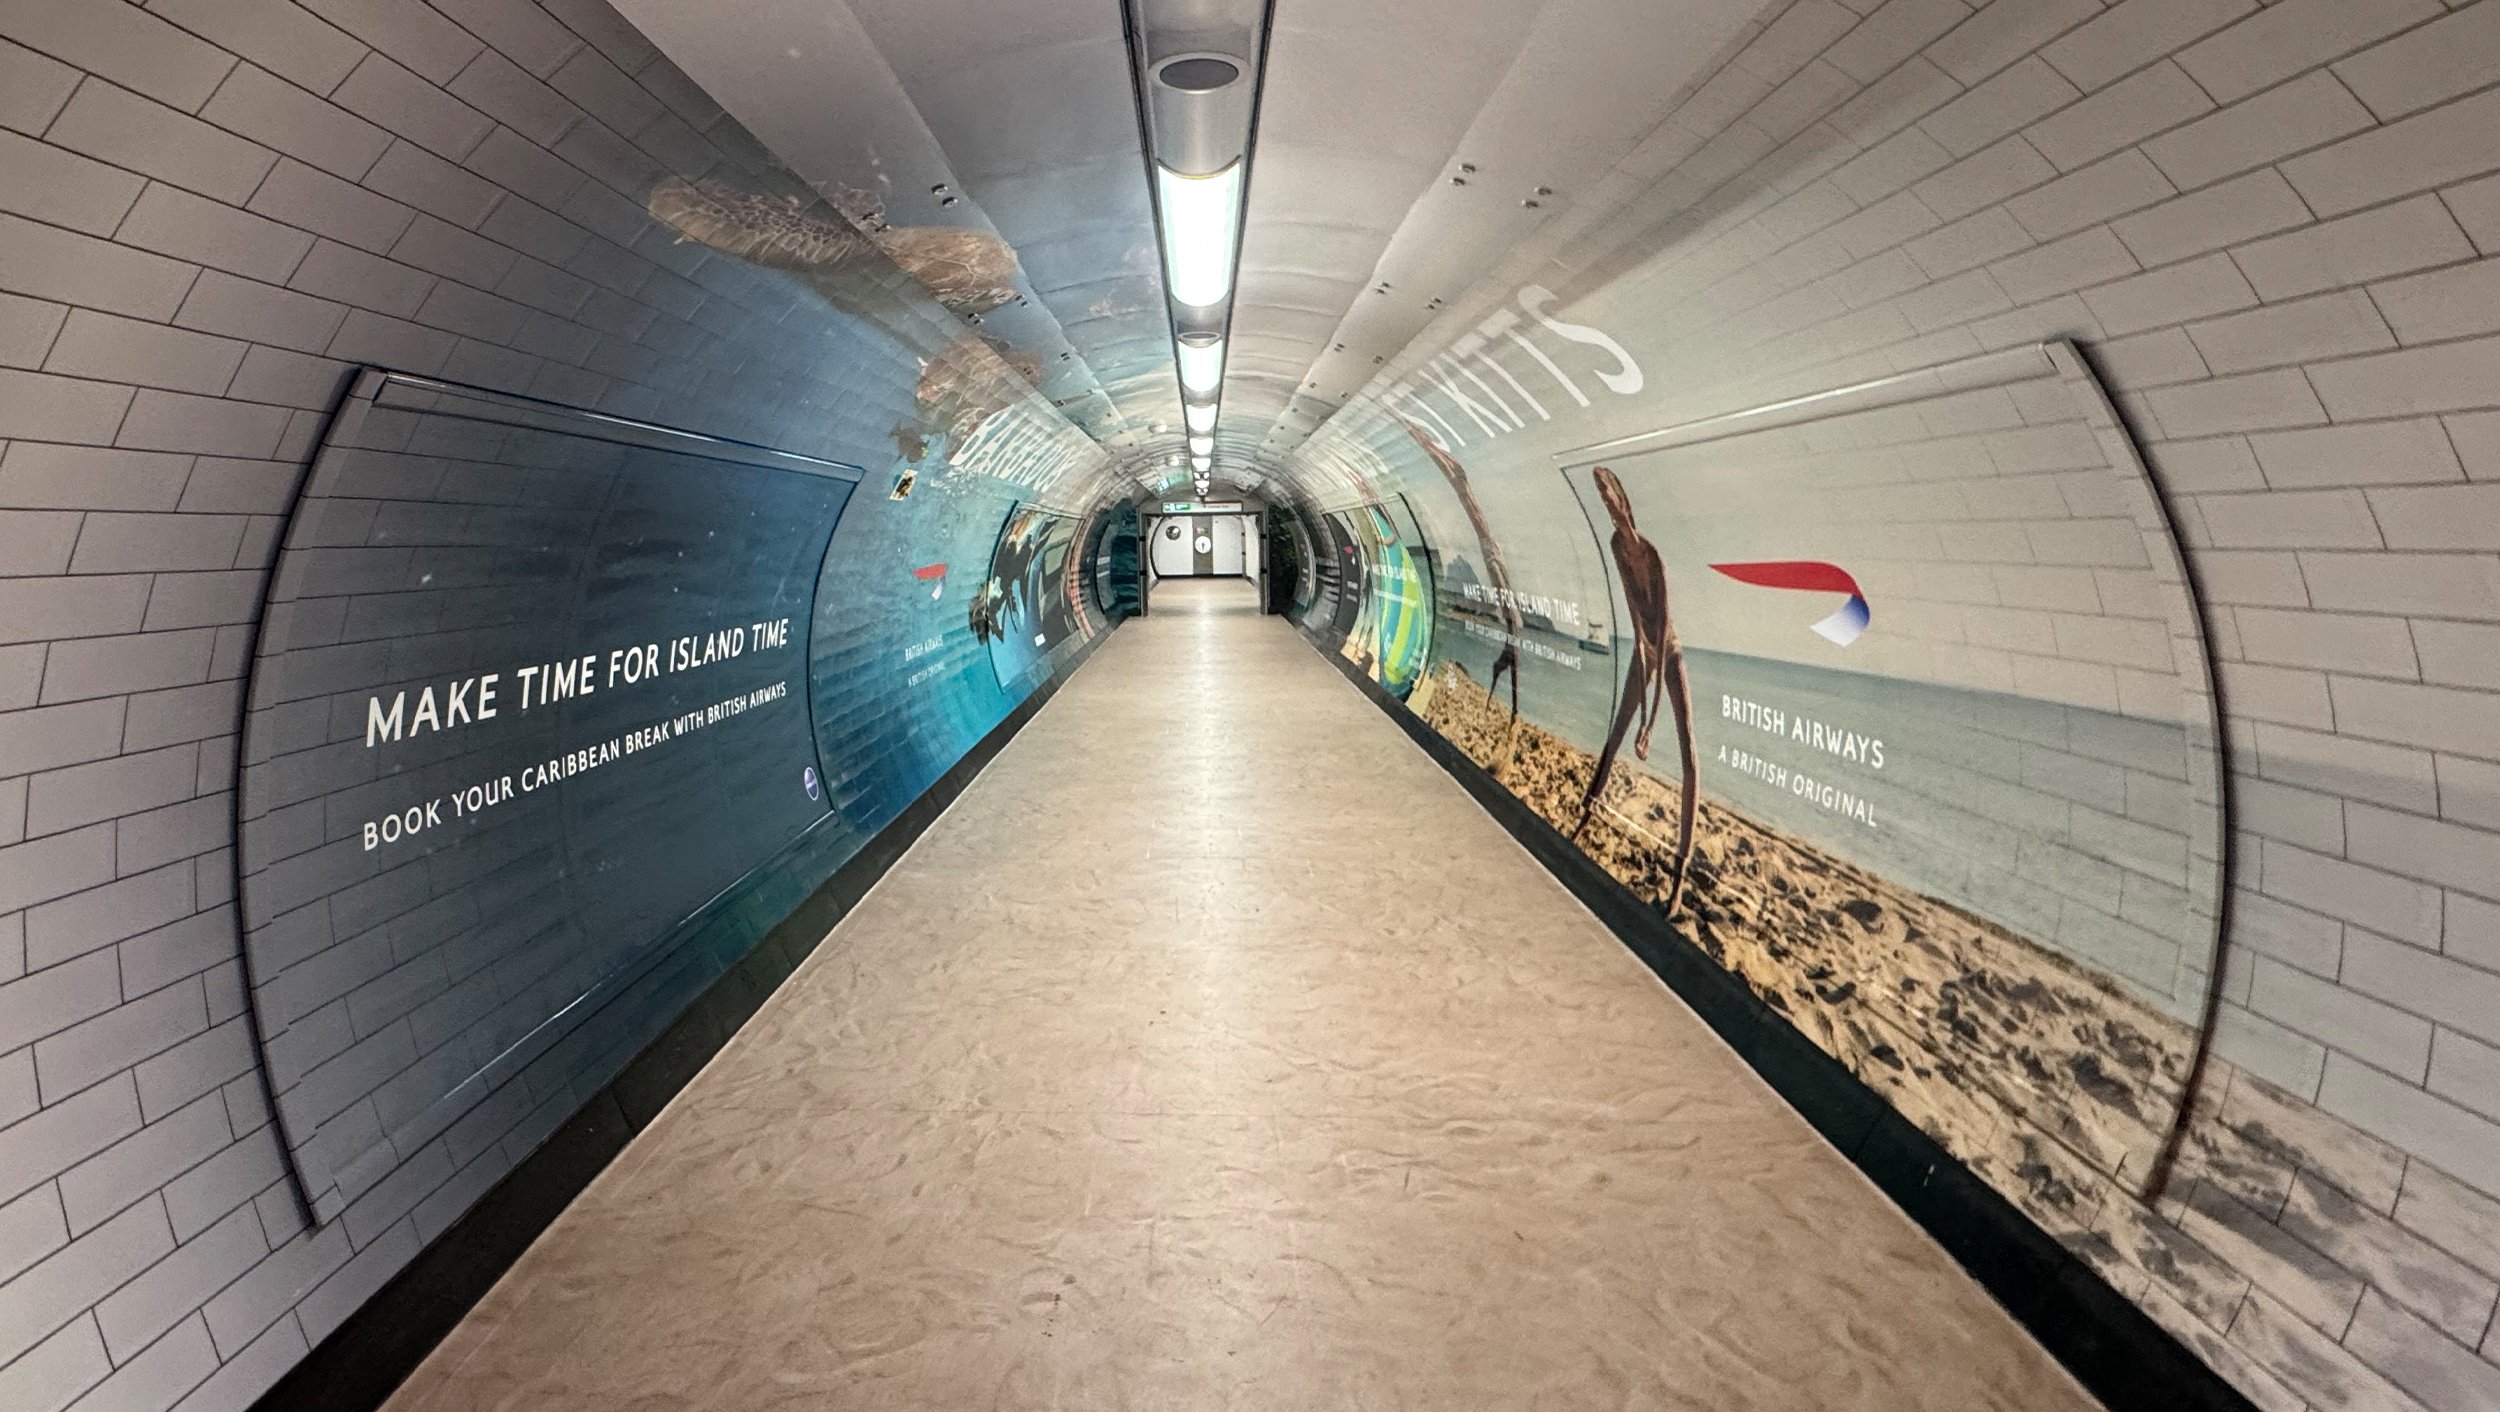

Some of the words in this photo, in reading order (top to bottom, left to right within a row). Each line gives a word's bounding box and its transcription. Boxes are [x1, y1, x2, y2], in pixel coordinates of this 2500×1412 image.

[1417, 284, 1644, 438] KITTS
[949, 403, 1076, 493] BARBADOS
[1462, 582, 1482, 603] MAKE
[1517, 591, 1551, 618] ISLAND
[1553, 597, 1580, 626] TIME
[366, 673, 499, 748] MAKE
[517, 655, 597, 710] TIME
[608, 644, 660, 688] FOR
[669, 627, 745, 673] ISLAND
[752, 618, 789, 652] TIME
[363, 799, 442, 851] BOOK
[452, 776, 515, 817] YOUR
[521, 739, 620, 792] CARIBBEAN
[626, 721, 671, 754] BREAK
[673, 710, 705, 736] WITH
[708, 695, 747, 724] BRITISH
[750, 681, 787, 708] AIRWAYS
[1722, 694, 1785, 736] BRITISH
[1791, 716, 1885, 769] AIRWAYS
[1718, 744, 1727, 764] A
[1731, 749, 1787, 788] BRITISH
[1792, 773, 1877, 828] ORIGINAL
